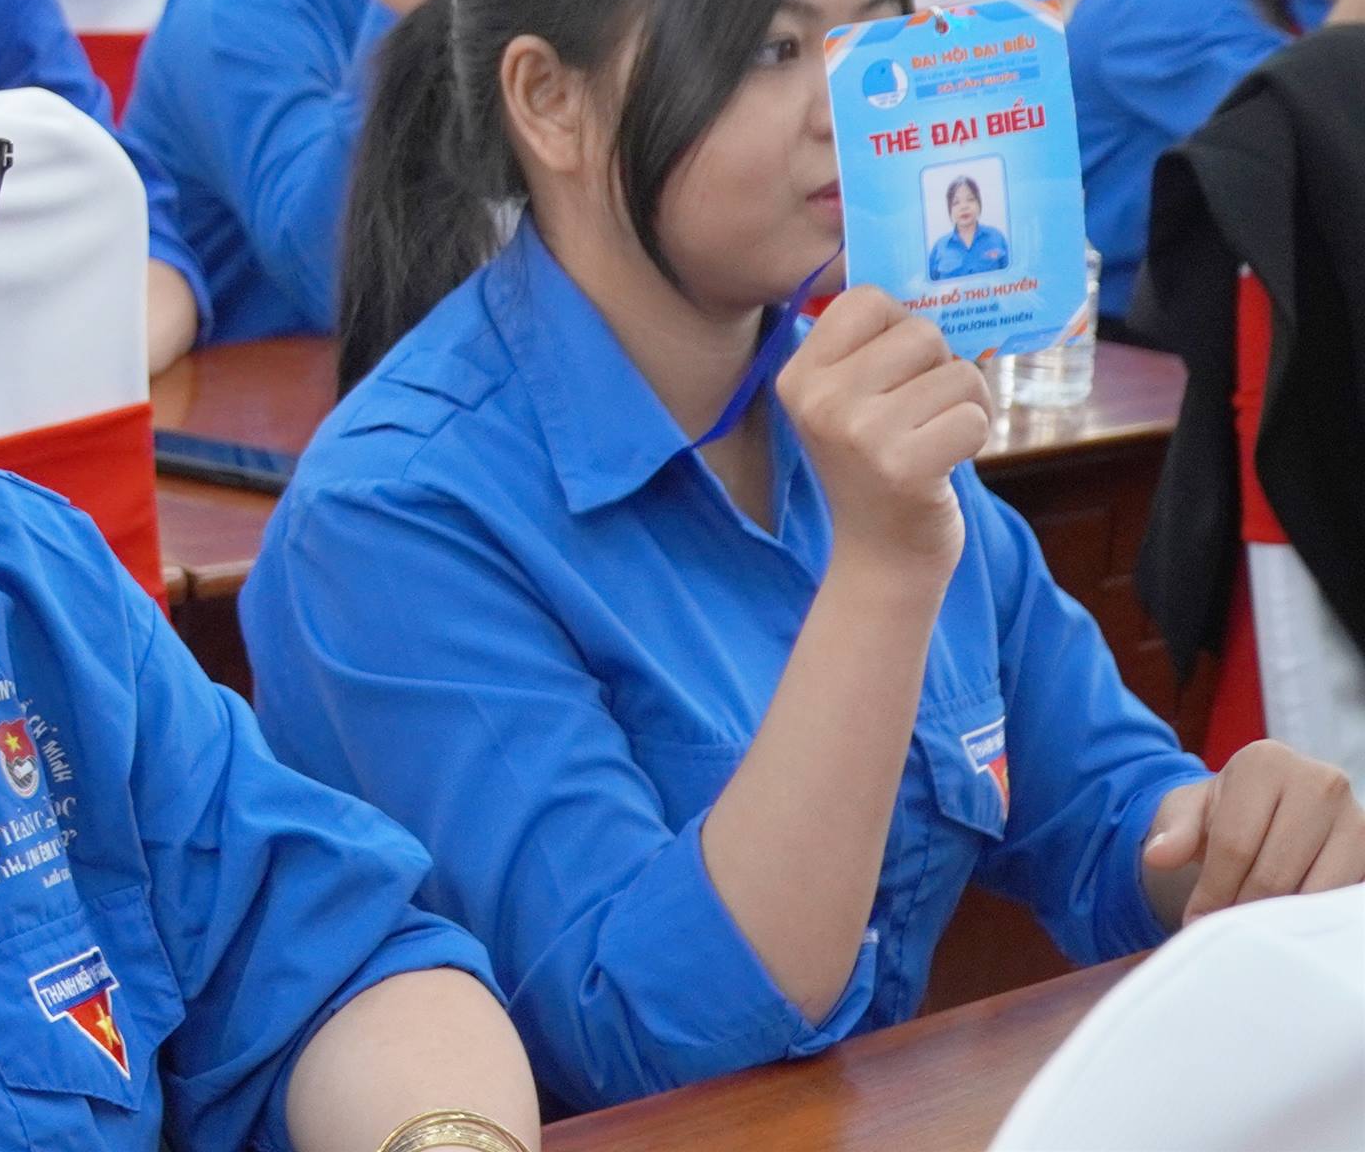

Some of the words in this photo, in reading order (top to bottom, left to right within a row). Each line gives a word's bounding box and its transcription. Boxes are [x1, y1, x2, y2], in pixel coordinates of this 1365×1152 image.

[869, 121, 922, 156] THẺ
[931, 117, 978, 147] ĐẠI
[986, 96, 1046, 136] BIỂU
